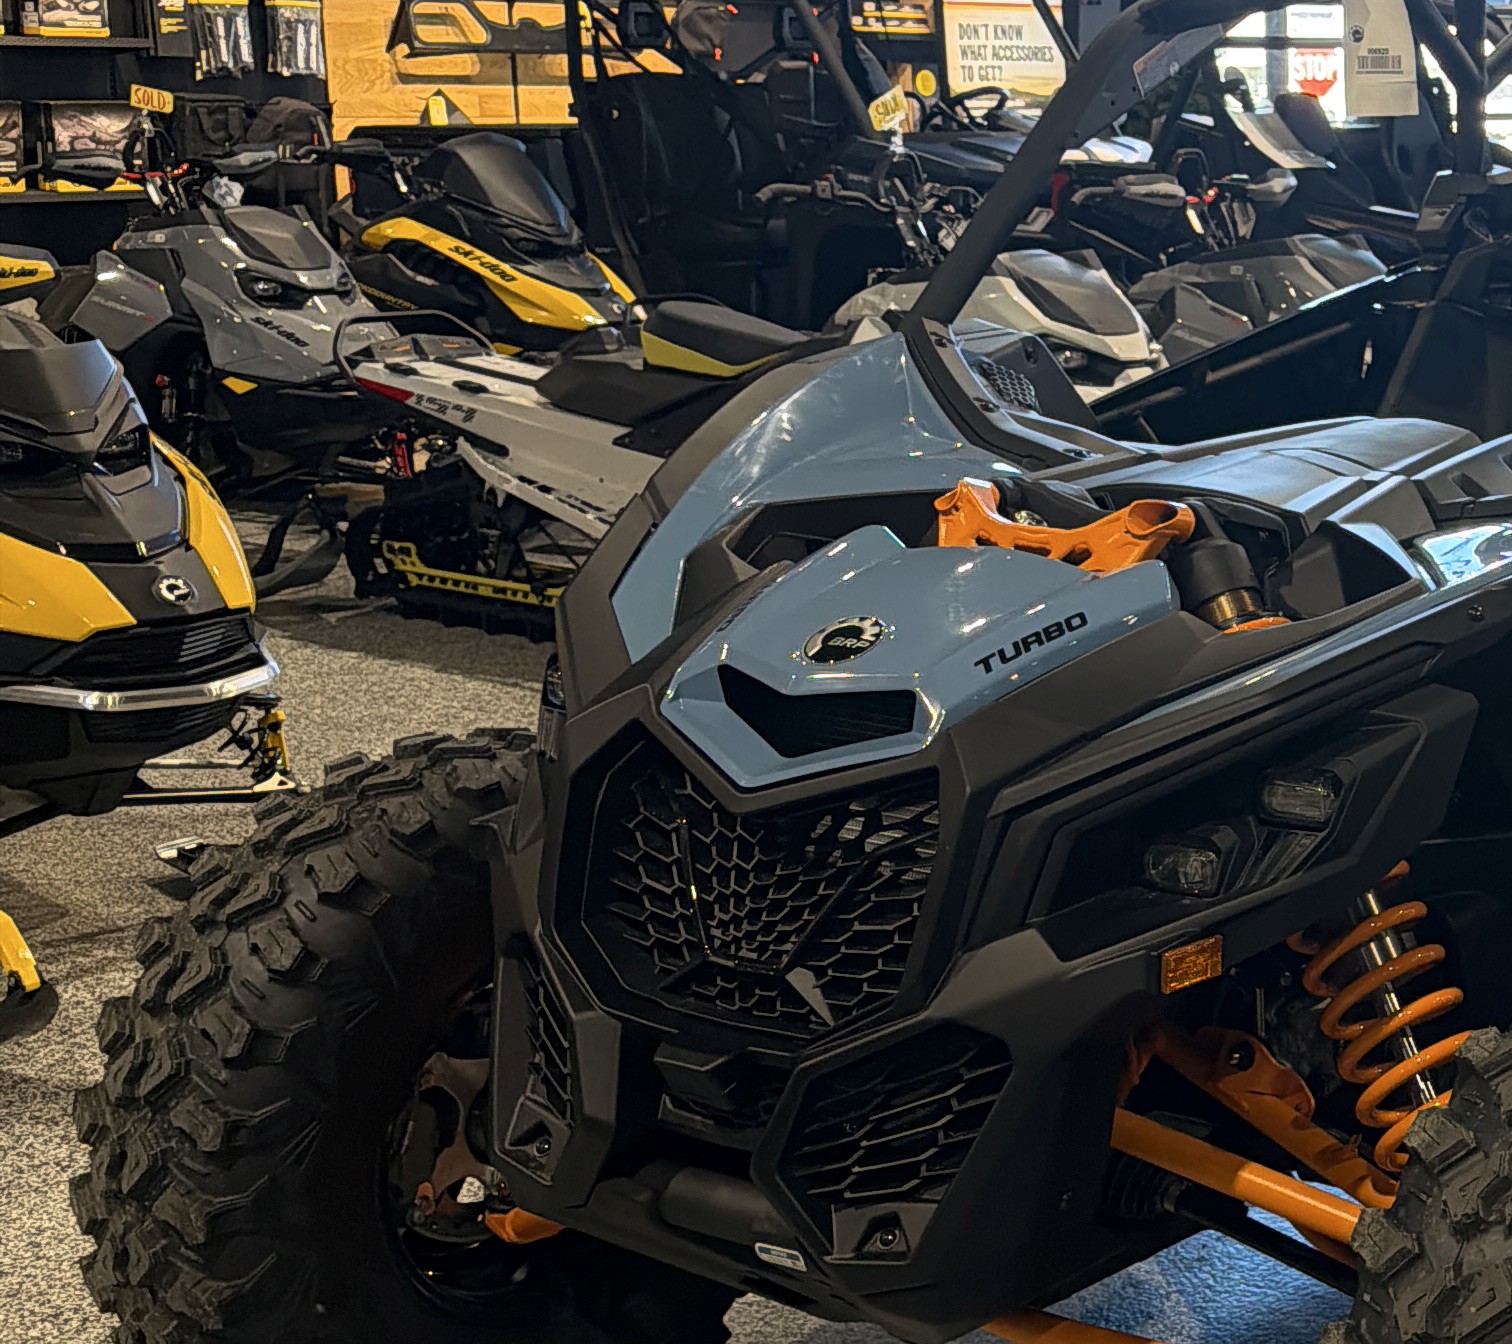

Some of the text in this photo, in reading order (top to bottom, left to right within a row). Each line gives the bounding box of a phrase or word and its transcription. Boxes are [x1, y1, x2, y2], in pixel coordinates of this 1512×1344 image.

[958, 23, 1024, 42] DON'T KNOW
[959, 44, 1055, 63] WHAT ACCESSORIES
[961, 65, 1004, 83] TO GET?
[134, 87, 167, 111] SOLD
[447, 245, 519, 283] ski-doo
[250, 316, 311, 348] ski-doo
[827, 636, 871, 649] BRP
[973, 611, 1089, 675] TURBO
